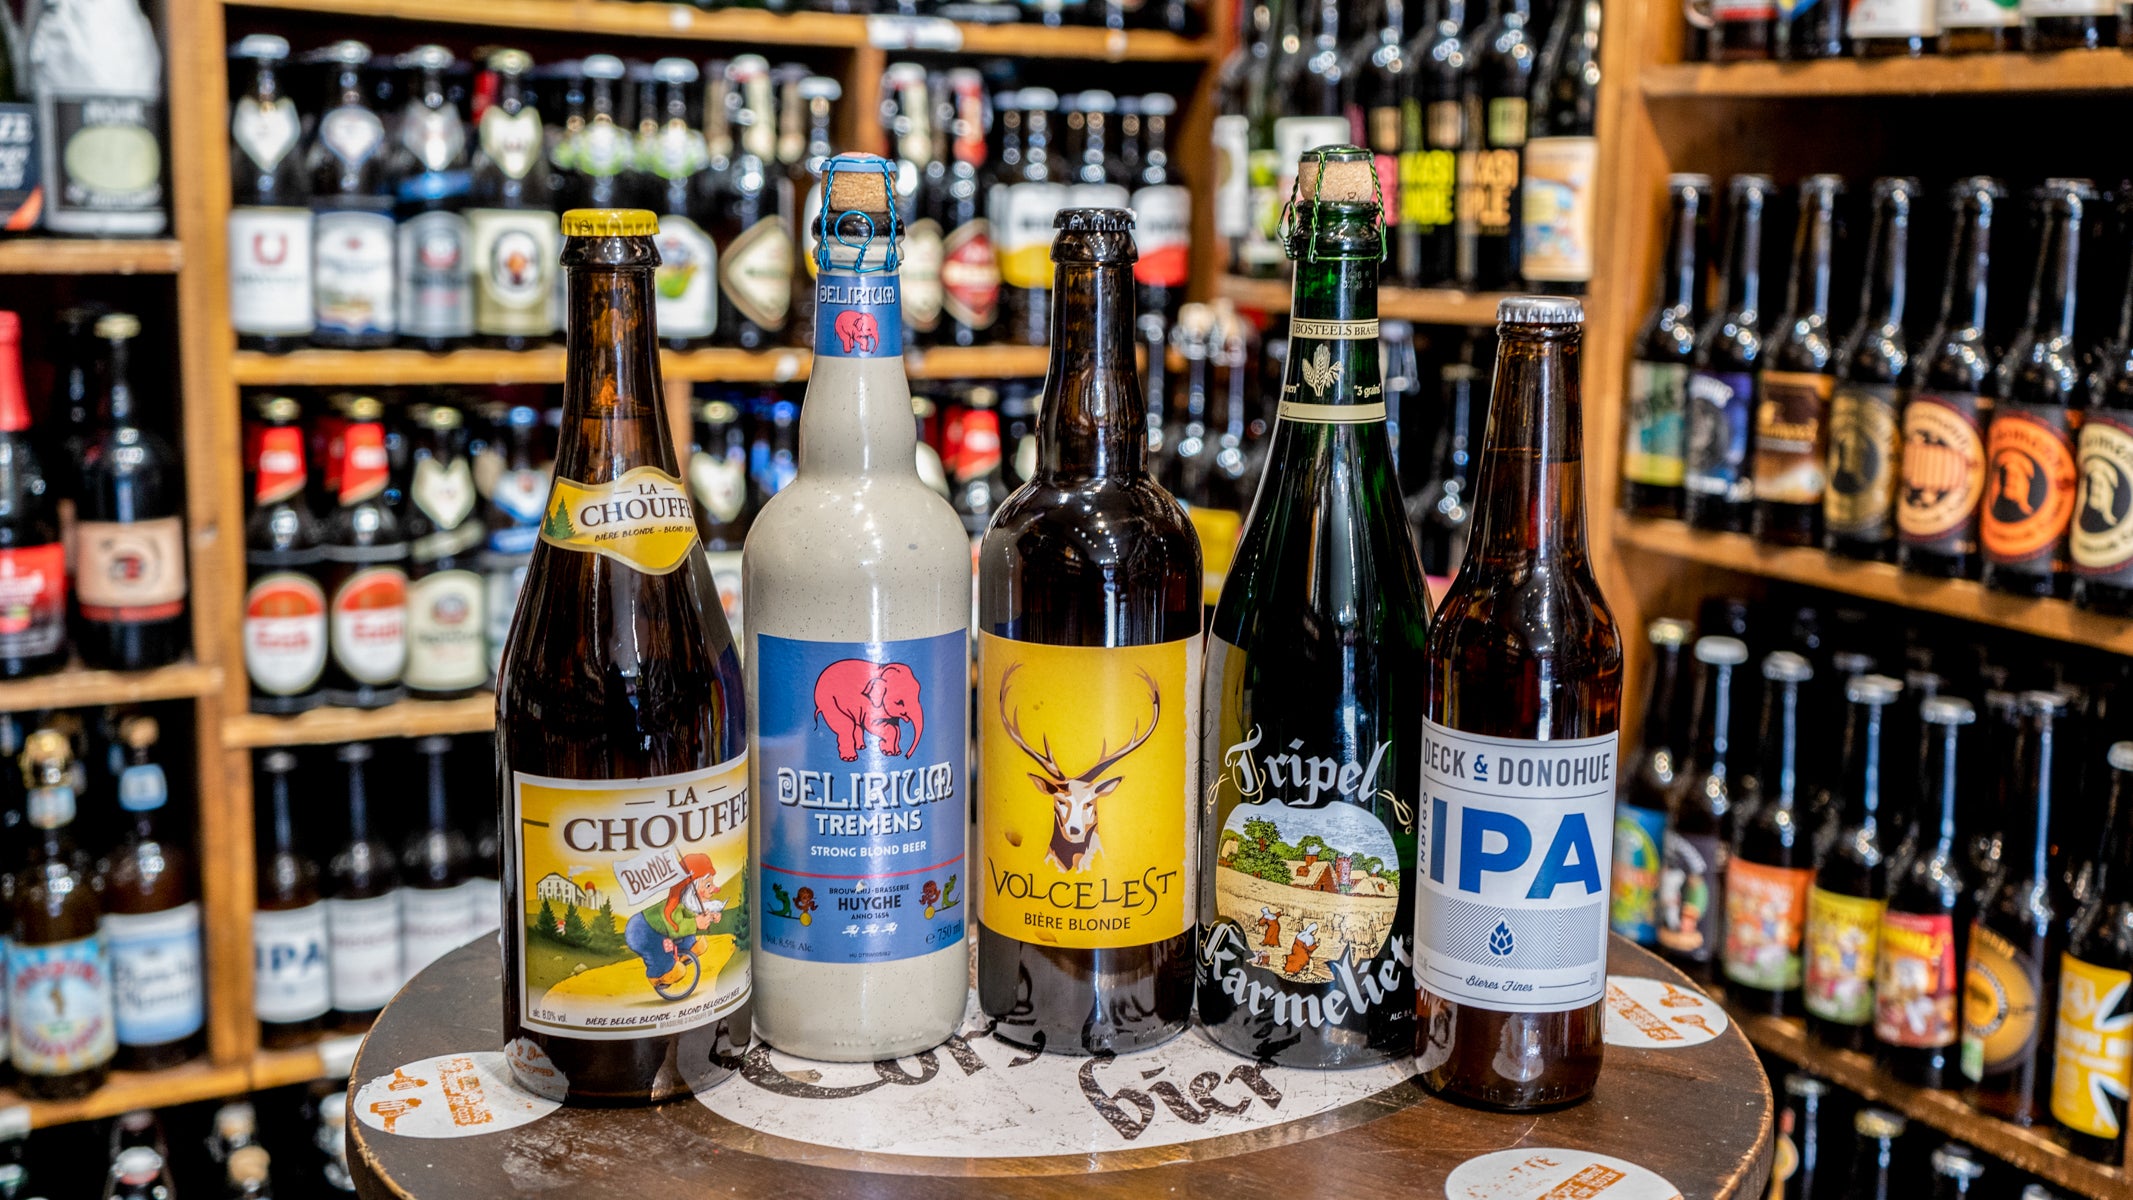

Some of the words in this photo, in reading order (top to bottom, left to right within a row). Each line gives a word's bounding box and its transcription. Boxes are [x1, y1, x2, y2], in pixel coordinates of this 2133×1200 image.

[820, 284, 897, 306] DELIRIUM
[1295, 324, 1353, 336] BOSTEELS
[638, 483, 658, 495] LA
[594, 531, 619, 542] BIÈRE
[622, 527, 655, 538] BLONDE
[1225, 724, 1392, 806] Tripel
[1424, 737, 1466, 778] DECK
[1473, 754, 1488, 781] &
[1498, 752, 1610, 787] DONOHUE
[777, 761, 954, 810] DELIRIUM
[666, 786, 699, 808] LA
[814, 810, 923, 836] TREMENS
[1420, 791, 1428, 874] INDIGO
[810, 845, 857, 858] STRONG
[860, 844, 899, 857] BLOND
[902, 840, 927, 854] BEER
[1430, 796, 1602, 899] IPA
[621, 851, 678, 895] BLONDE
[988, 856, 1177, 916] VOLCELEST
[838, 894, 902, 911] HUYGHE
[851, 912, 873, 920] ANNO
[1024, 912, 1063, 929] BIÈRE
[1068, 916, 1131, 931] BLONDE
[937, 923, 952, 942] 750
[1203, 922, 1413, 1029] Karmeliet
[1502, 979, 1533, 992] Fines
[585, 1015, 608, 1026] BIÈRE
[610, 1017, 638, 1026] BELGE
[639, 1011, 671, 1024] BLONDE
[678, 1005, 702, 1018] BLOND
[1078, 1054, 1284, 1141] bier
